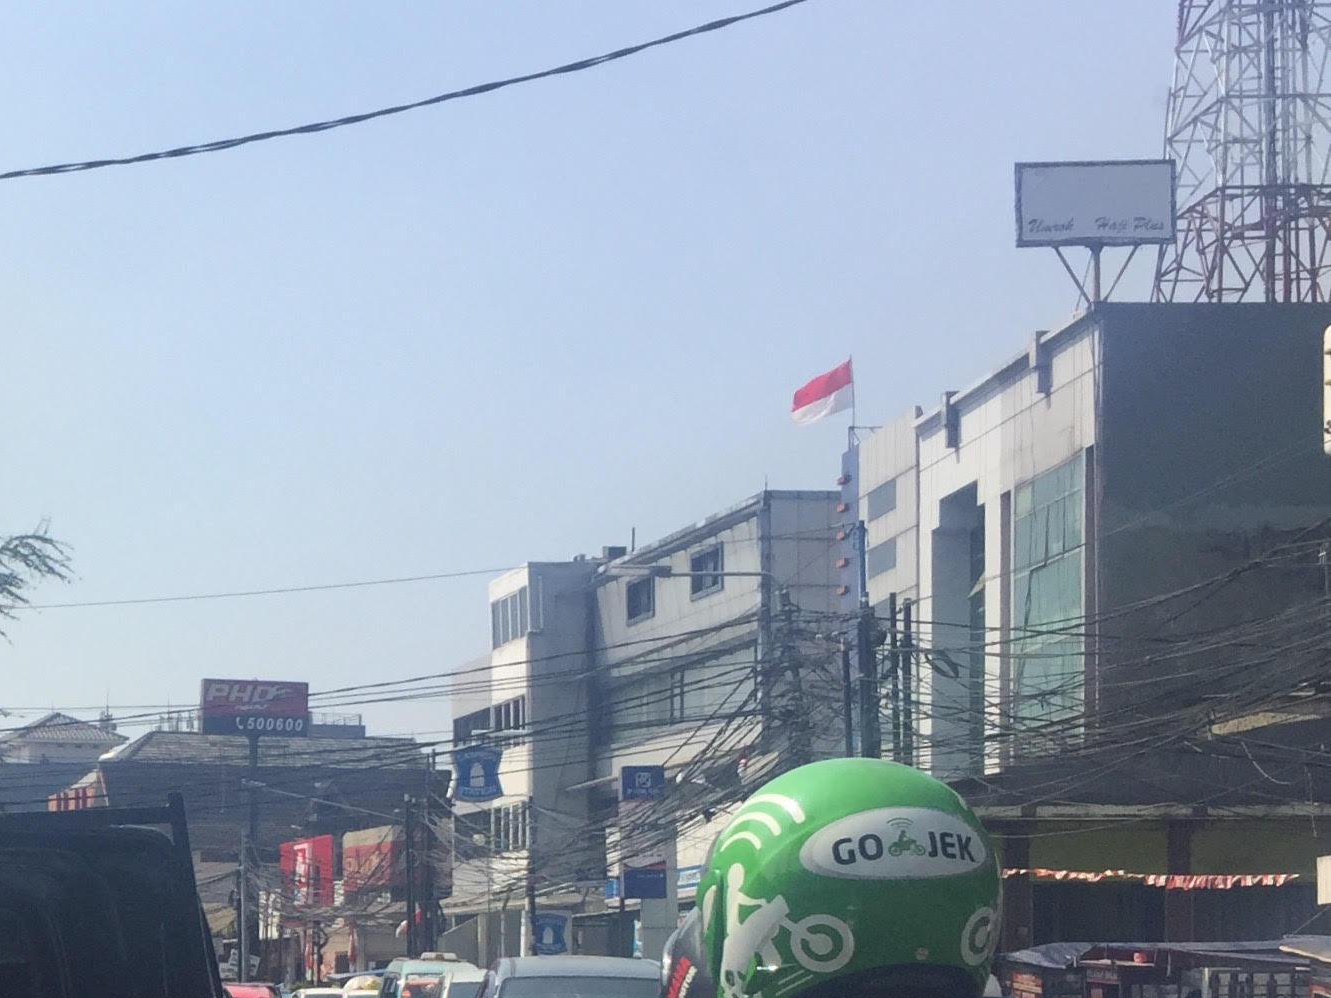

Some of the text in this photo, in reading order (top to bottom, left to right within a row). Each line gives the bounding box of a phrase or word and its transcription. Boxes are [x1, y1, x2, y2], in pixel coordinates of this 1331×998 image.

[1095, 216, 1127, 234] Haji
[1133, 216, 1164, 232] Plus
[246, 718, 304, 732] 500600
[832, 830, 976, 865] GO JEK
